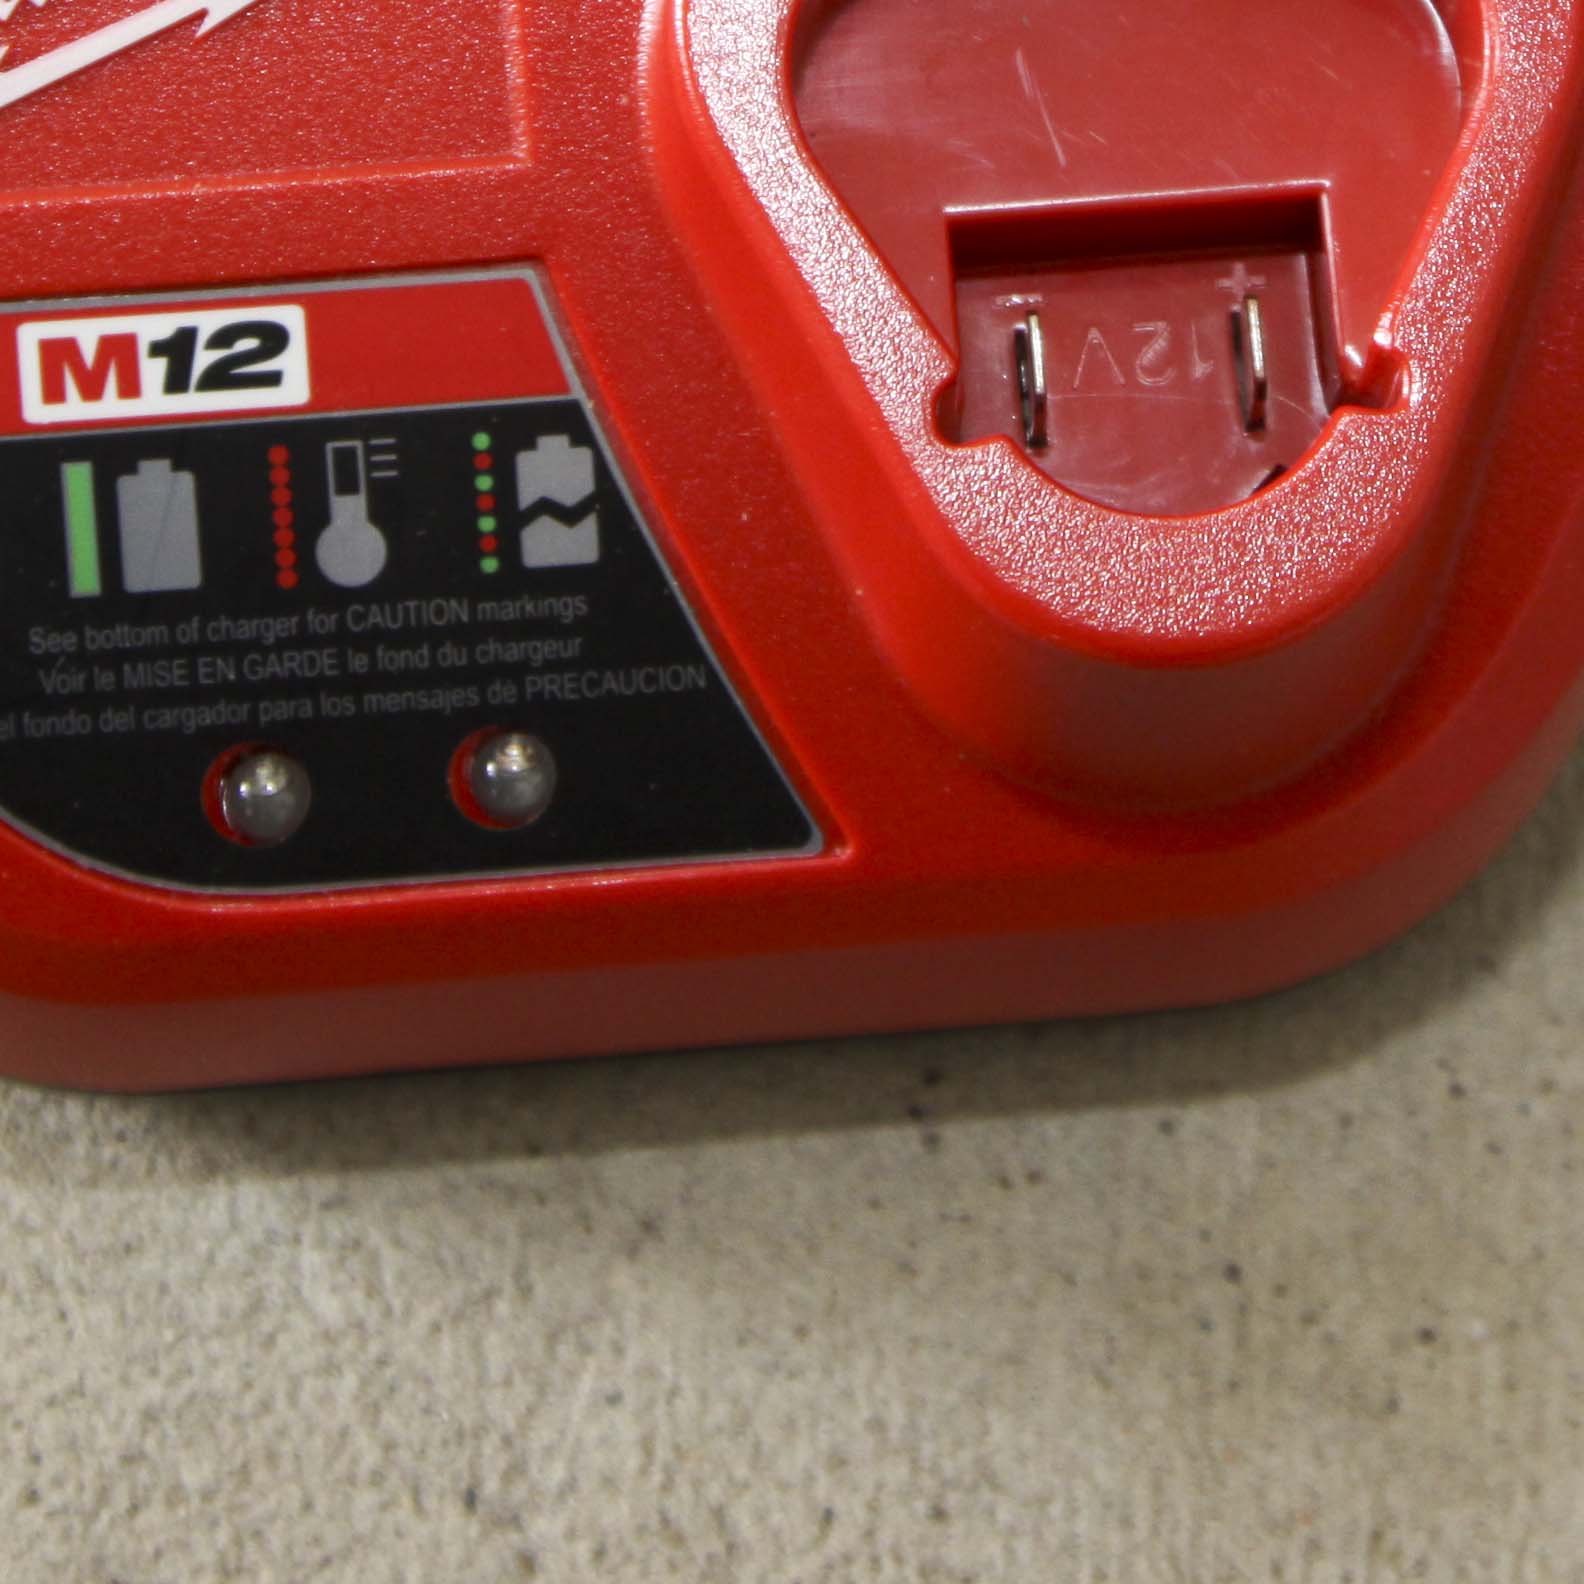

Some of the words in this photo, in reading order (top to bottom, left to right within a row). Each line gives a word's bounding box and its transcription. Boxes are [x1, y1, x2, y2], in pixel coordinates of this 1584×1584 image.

[38, 320, 291, 404] M12
[1072, 320, 1215, 388] 12V
[28, 626, 77, 655] See
[84, 624, 169, 651] bottom
[176, 616, 200, 644] of
[207, 612, 299, 645] charger
[307, 608, 337, 634] for
[346, 597, 470, 634] CAUTION
[477, 594, 589, 623] markings
[39, 666, 86, 695] Voir
[94, 665, 116, 691] le
[123, 658, 190, 690] MISE
[198, 656, 236, 684] EN
[242, 648, 340, 682] GARDE
[348, 647, 369, 674] le
[376, 642, 430, 672] fond
[437, 640, 468, 667] du
[475, 636, 583, 667] chargeur
[23, 708, 92, 738] fondo
[98, 705, 136, 733] del
[143, 698, 251, 735] cargador
[258, 695, 313, 724] para
[321, 691, 355, 717] los
[363, 683, 479, 714] mensajes
[524, 664, 707, 702] PRECAUCION
